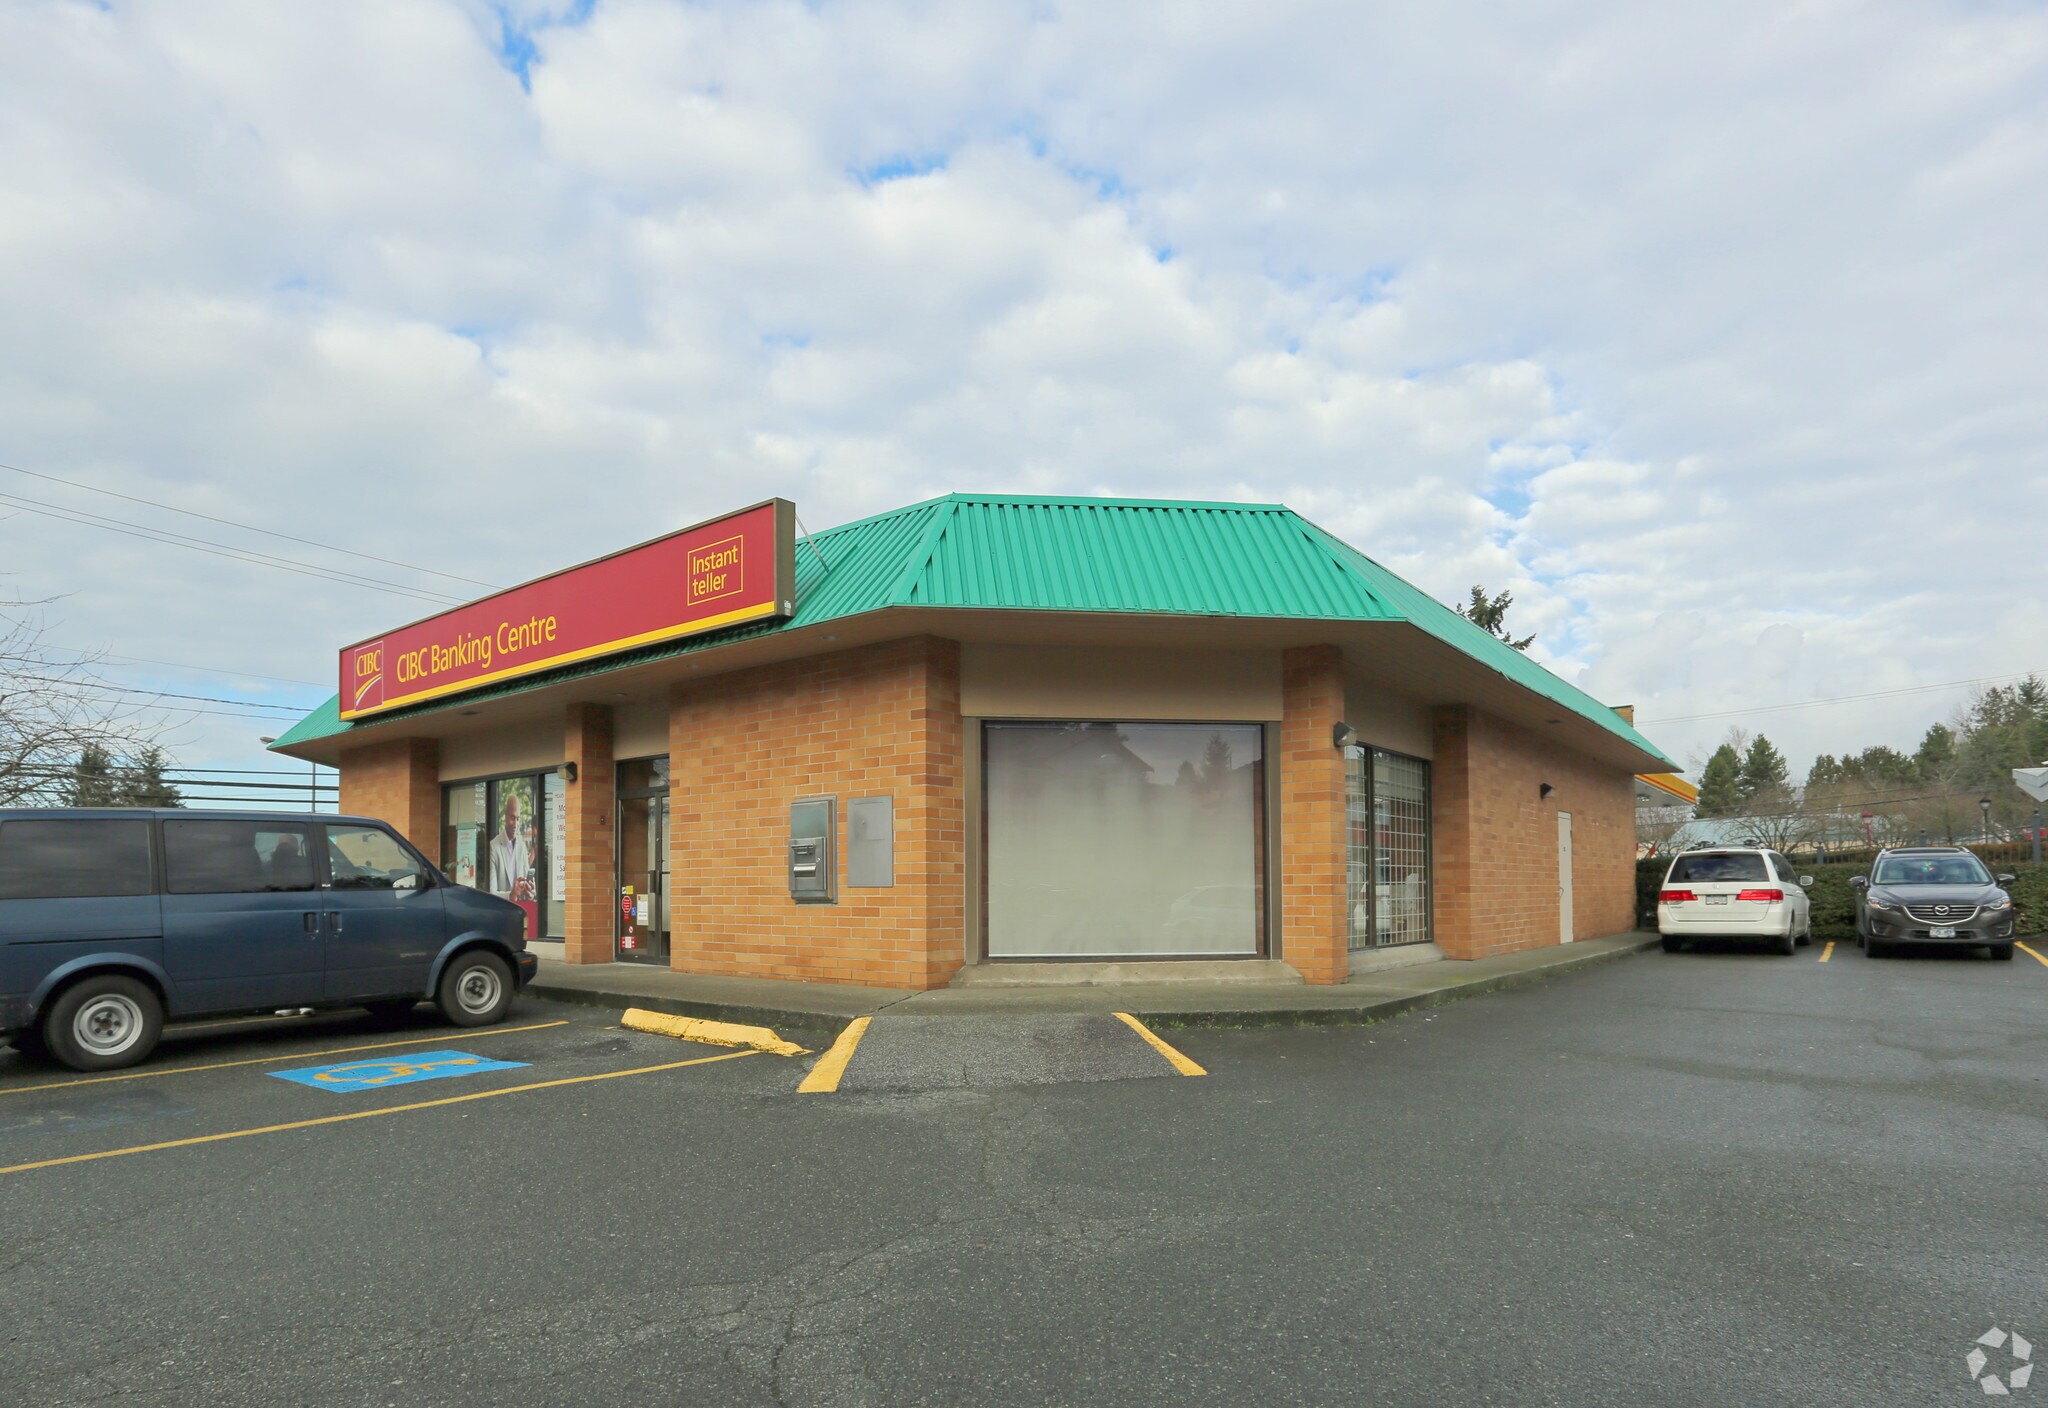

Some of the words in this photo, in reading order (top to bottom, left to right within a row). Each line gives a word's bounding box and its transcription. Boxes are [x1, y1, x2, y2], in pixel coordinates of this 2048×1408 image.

[693, 544, 738, 575] Instant
[692, 572, 727, 597] teller
[356, 649, 381, 677] CIBC
[396, 647, 428, 683] CIBC
[431, 632, 491, 669] Banking
[496, 615, 557, 655] Centre
